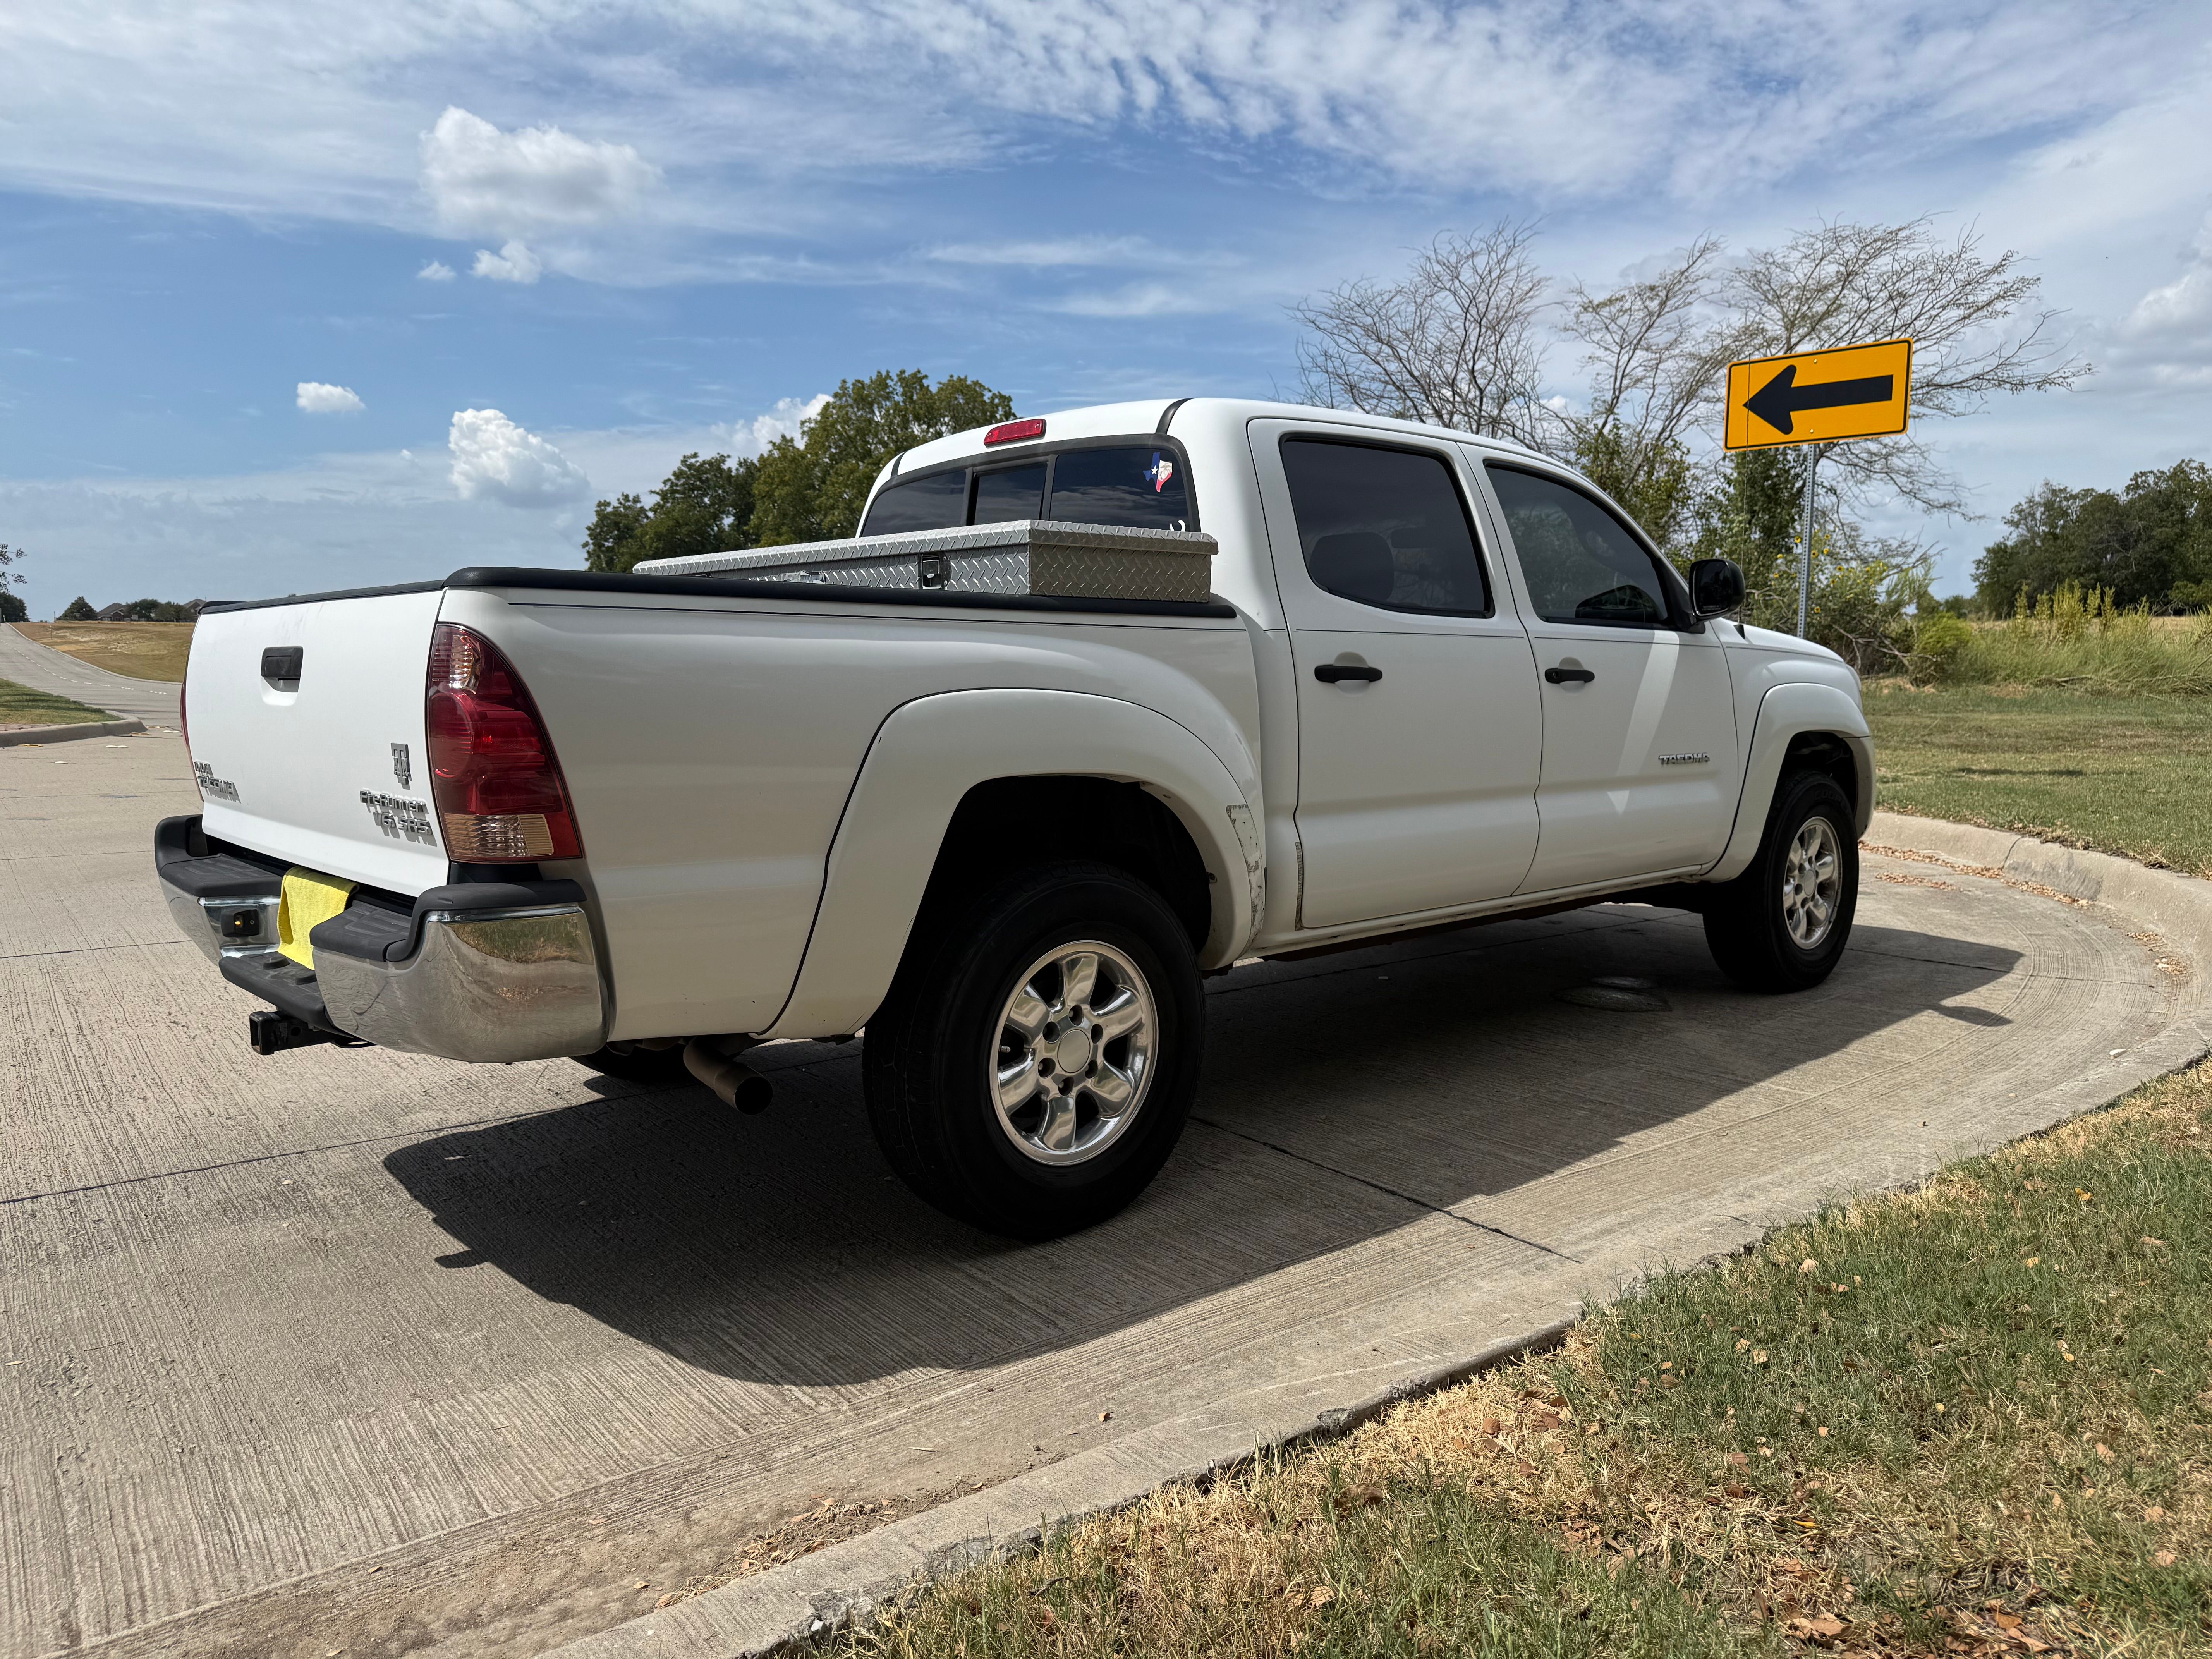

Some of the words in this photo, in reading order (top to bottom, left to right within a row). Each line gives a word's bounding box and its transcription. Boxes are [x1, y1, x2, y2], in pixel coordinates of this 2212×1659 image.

[1658, 752, 1710, 765] TACOMA
[198, 775, 234, 795] TACOMA
[360, 790, 426, 812] PreRunner
[373, 812, 396, 828] V6
[398, 816, 433, 835] SR5
